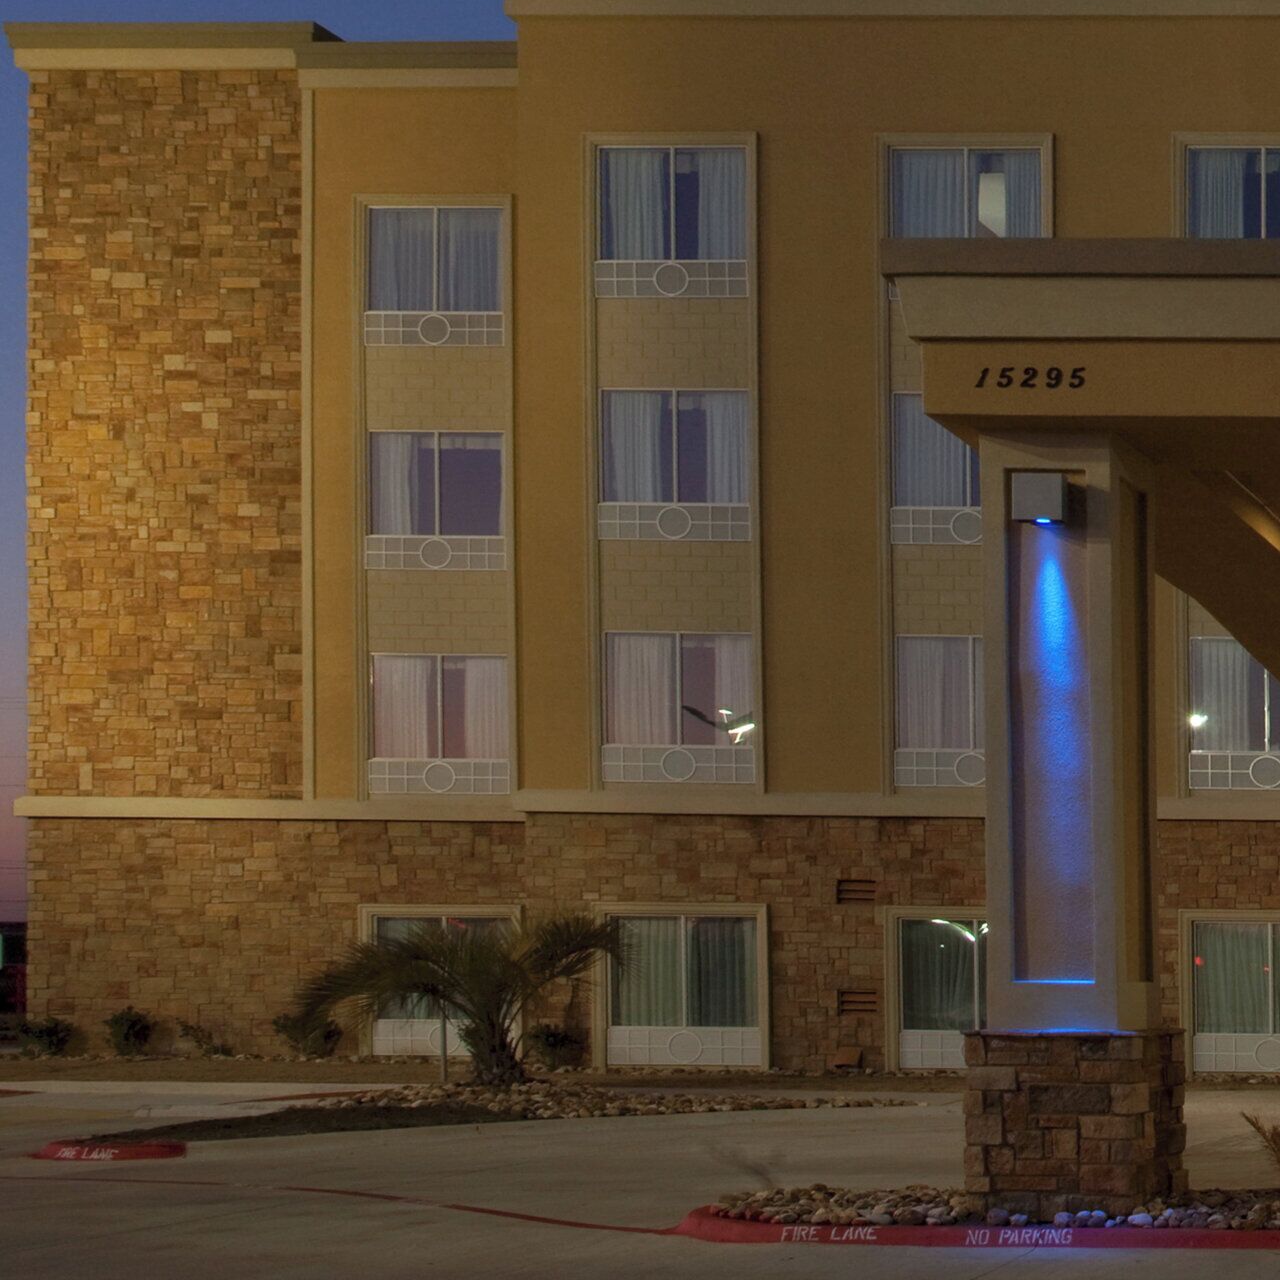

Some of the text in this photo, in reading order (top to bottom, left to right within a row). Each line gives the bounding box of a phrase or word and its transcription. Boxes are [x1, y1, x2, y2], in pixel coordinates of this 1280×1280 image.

[975, 366, 1087, 389] 15295
[780, 1225, 881, 1242] FIRE LANE
[965, 1228, 1073, 1245] NO PARKING
